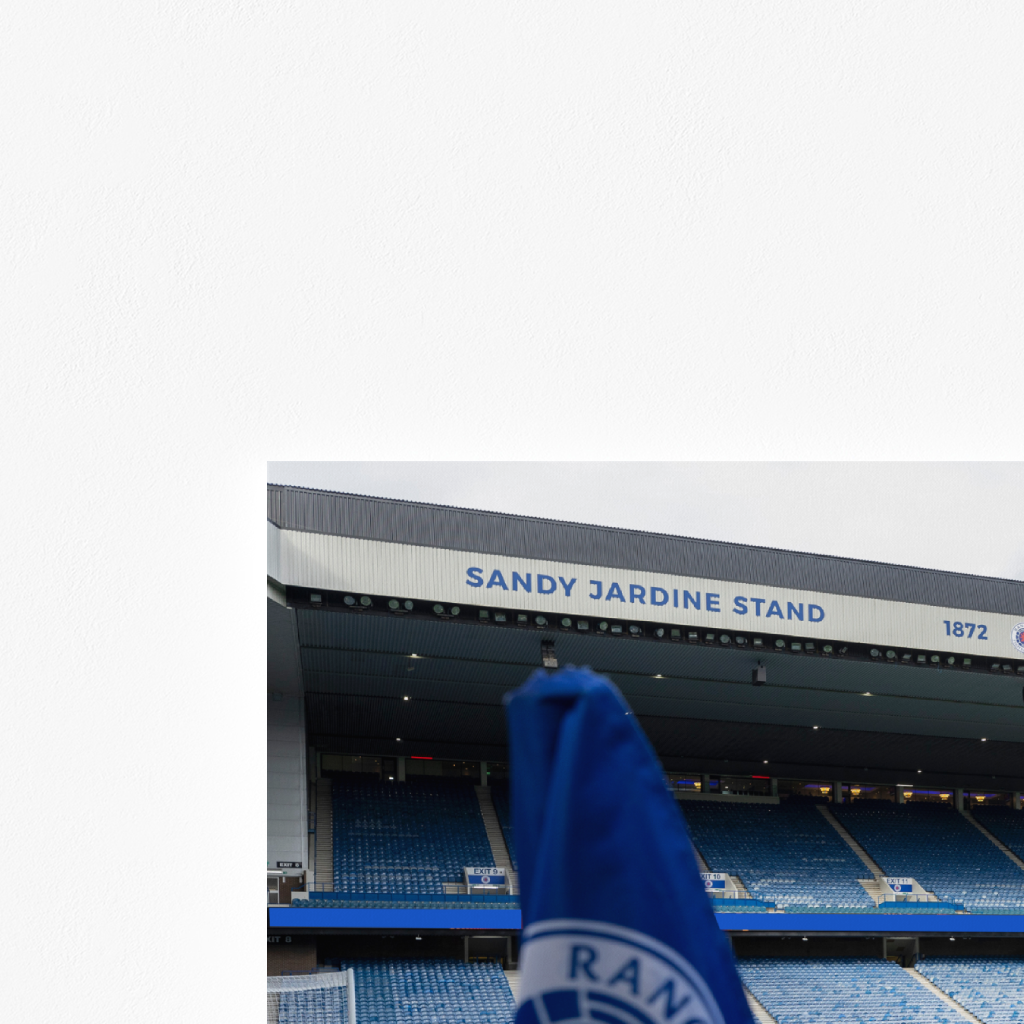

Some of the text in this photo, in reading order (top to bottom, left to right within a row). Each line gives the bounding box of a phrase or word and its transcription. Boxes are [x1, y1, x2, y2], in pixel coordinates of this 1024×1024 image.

[465, 566, 826, 623] SANDY JARDINE STAND
[943, 620, 989, 641] 1872
